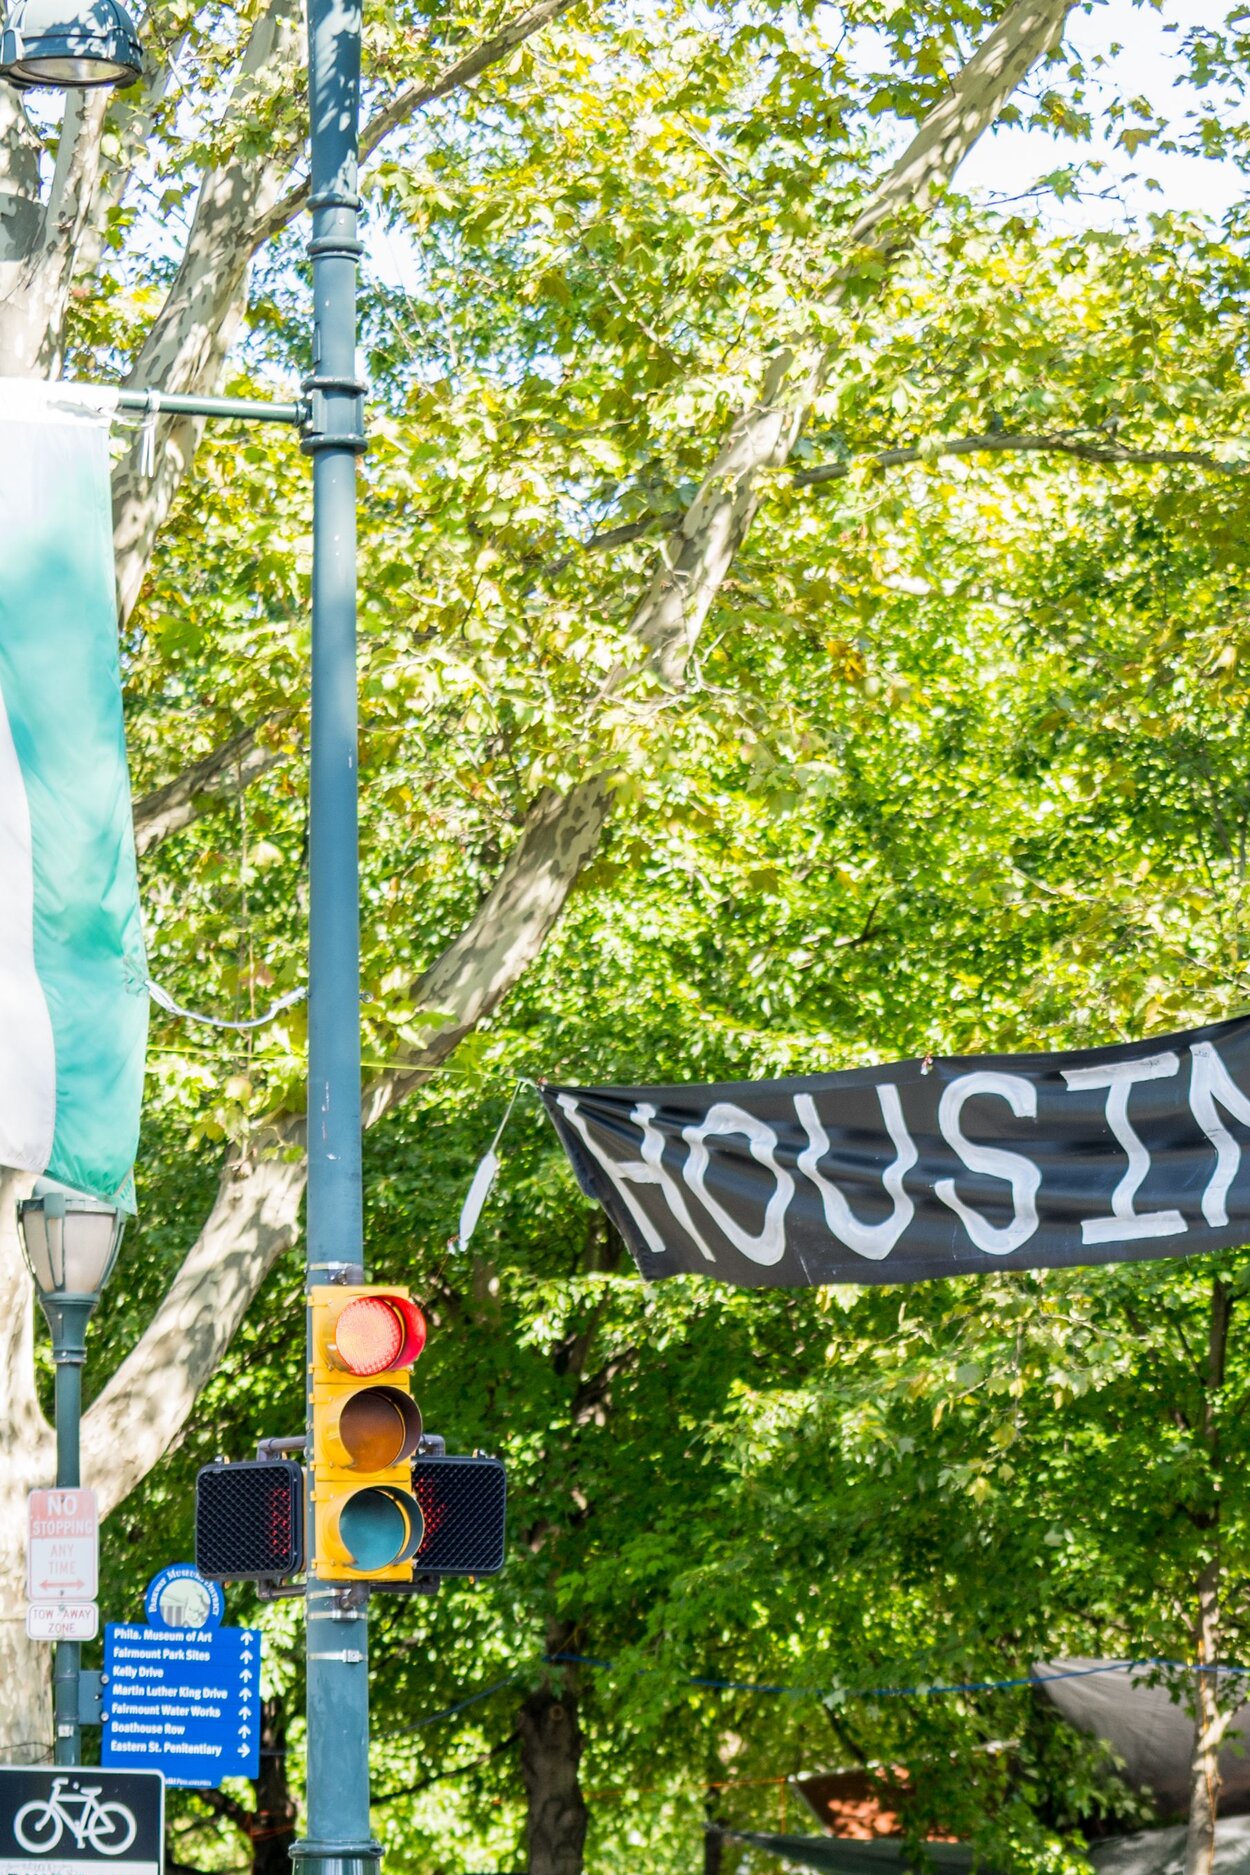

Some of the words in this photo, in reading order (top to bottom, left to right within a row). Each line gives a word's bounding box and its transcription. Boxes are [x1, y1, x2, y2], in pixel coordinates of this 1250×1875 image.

[47, 1495, 78, 1516] NO
[33, 1520, 93, 1536] STOPPING
[50, 1543, 74, 1557] ANY
[48, 1561, 76, 1575] TIME
[48, 1622, 76, 1633] ZONE
[113, 1628, 141, 1640] Phila.
[143, 1629, 183, 1642] Museum
[186, 1631, 196, 1642] of
[197, 1632, 213, 1643] Art
[113, 1647, 161, 1659] Fairmount
[163, 1649, 184, 1660] Park
[186, 1650, 211, 1661] Sites
[113, 1665, 137, 1679] Kelly
[139, 1666, 164, 1678] Drive
[112, 1684, 145, 1696] Martin
[146, 1685, 177, 1697] Luther
[179, 1687, 201, 1700] King
[203, 1688, 228, 1699] Drive
[112, 1703, 160, 1715] Fairmount
[161, 1705, 189, 1716] Water
[191, 1706, 221, 1718] Works
[111, 1721, 163, 1734] Boathouse
[164, 1722, 185, 1735] Row
[111, 1740, 147, 1752] Eastern
[148, 1741, 162, 1753] St.
[164, 1741, 222, 1757] Penitentiary
